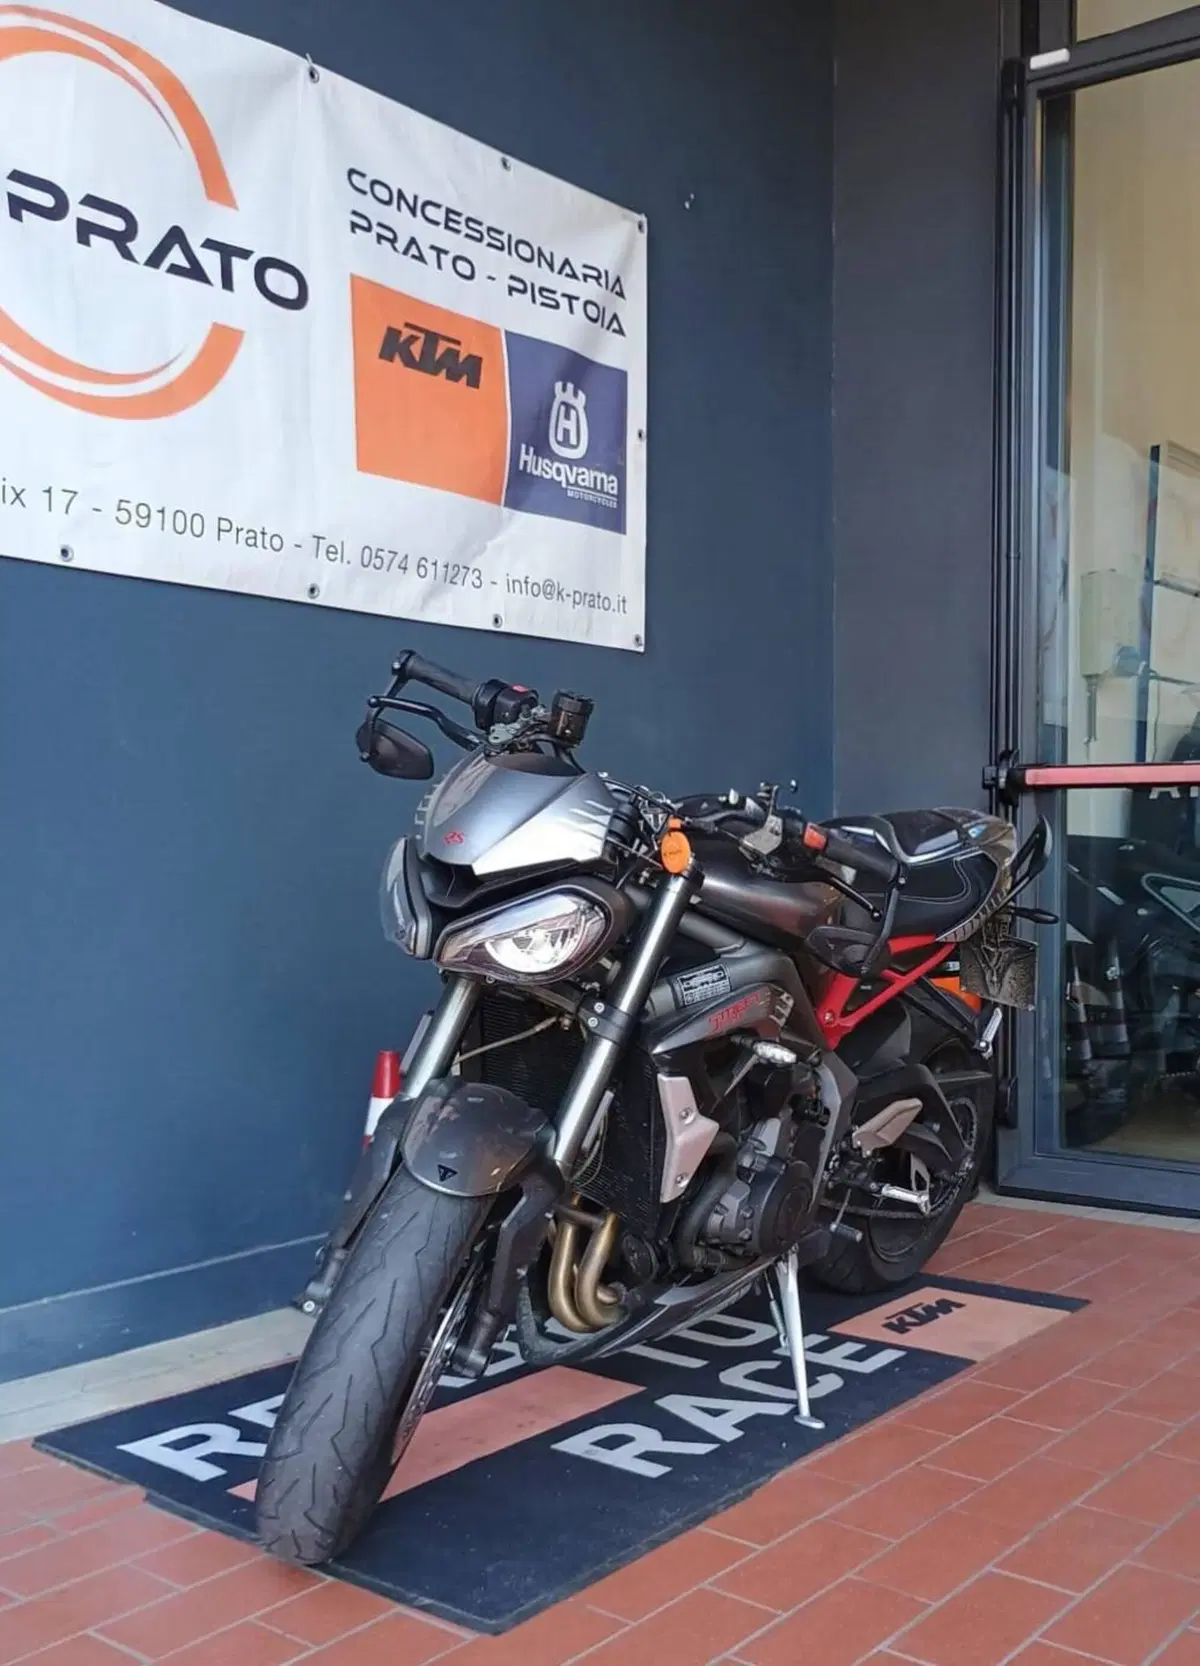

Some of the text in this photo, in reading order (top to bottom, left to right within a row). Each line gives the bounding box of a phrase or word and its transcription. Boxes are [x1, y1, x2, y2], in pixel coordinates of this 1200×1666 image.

[6, 168, 309, 311] PRATO
[347, 167, 627, 300] CONCESSIONARIA
[350, 209, 476, 281] PRATO
[507, 274, 627, 338] PISTOIA
[378, 322, 483, 389] KTM
[518, 443, 618, 495] Husqvarna
[42, 486, 79, 515] 17
[115, 499, 205, 538] 59100
[217, 516, 284, 553] Prato
[312, 534, 351, 565] Tel.
[360, 545, 409, 575] 0574
[416, 556, 483, 589] 611273
[506, 573, 627, 614] info@k-prato.it
[881, 1298, 967, 1334] KTM
[550, 1333, 907, 1479] RACE
